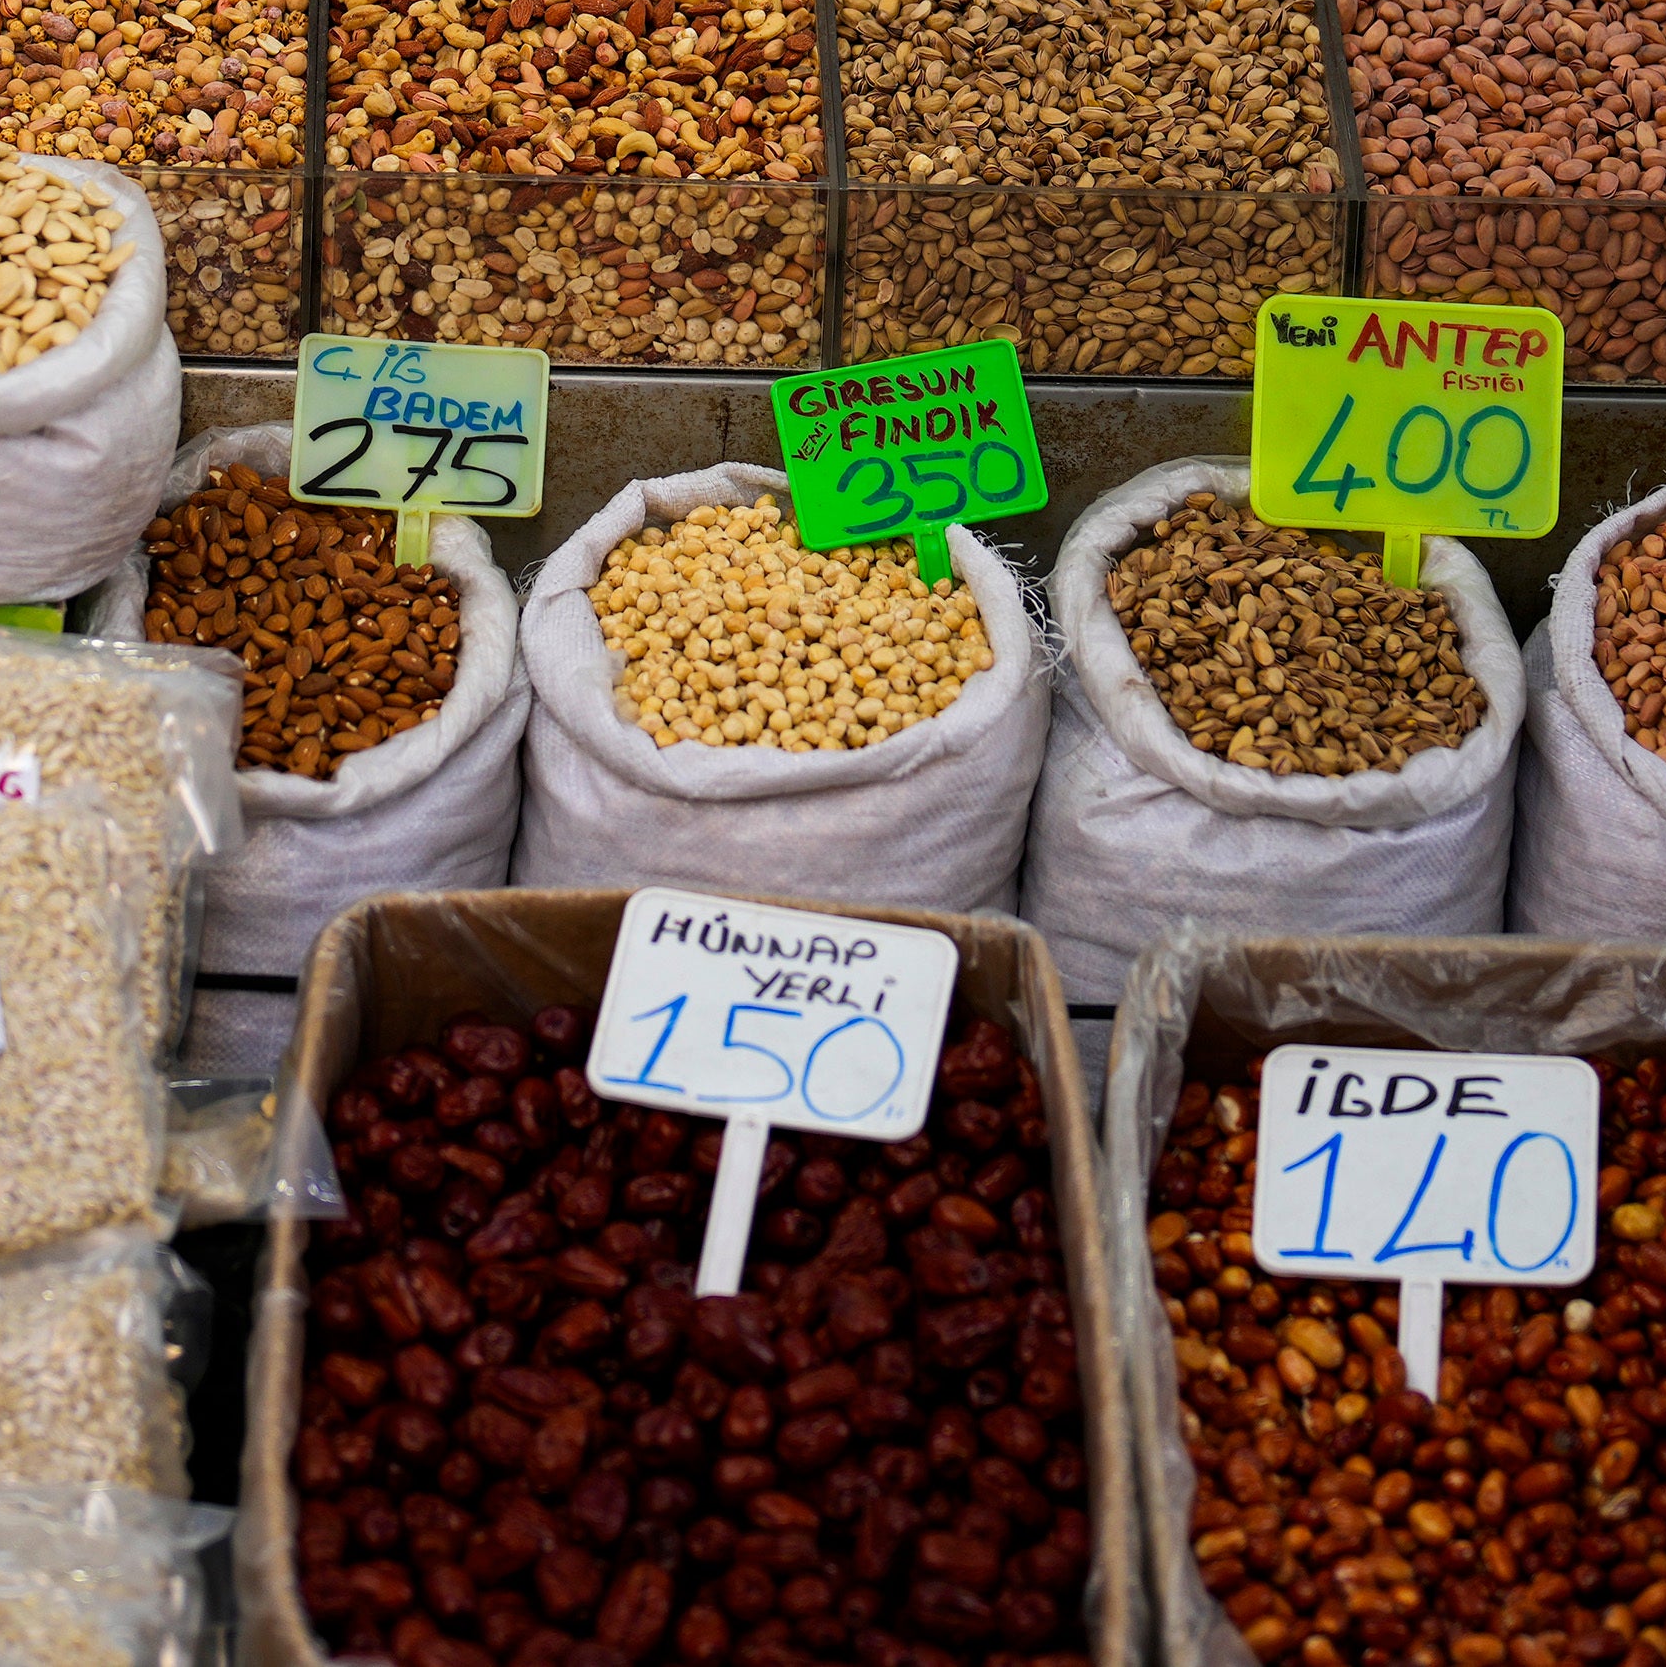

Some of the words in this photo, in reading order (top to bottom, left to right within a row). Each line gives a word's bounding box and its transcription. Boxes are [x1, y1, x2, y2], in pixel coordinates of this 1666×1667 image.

[313, 343, 433, 385] ÇİĞ
[1268, 312, 1338, 350] YENİ
[1346, 312, 1549, 370] ANTEP
[788, 364, 978, 418] GİRESUN
[1442, 370, 1525, 393] FISTIĞI
[363, 386, 523, 433] BADEM
[838, 397, 1009, 453] FINDIK
[300, 418, 530, 507] 275
[789, 420, 834, 463] YENİ
[1292, 393, 1532, 515] 400
[835, 439, 1028, 534] 350
[1478, 507, 1520, 532] TL
[651, 912, 878, 966] HÜNNAP
[746, 964, 898, 1013] YERLİ
[602, 994, 903, 1122] 150
[1278, 1130, 1577, 1273] 140
